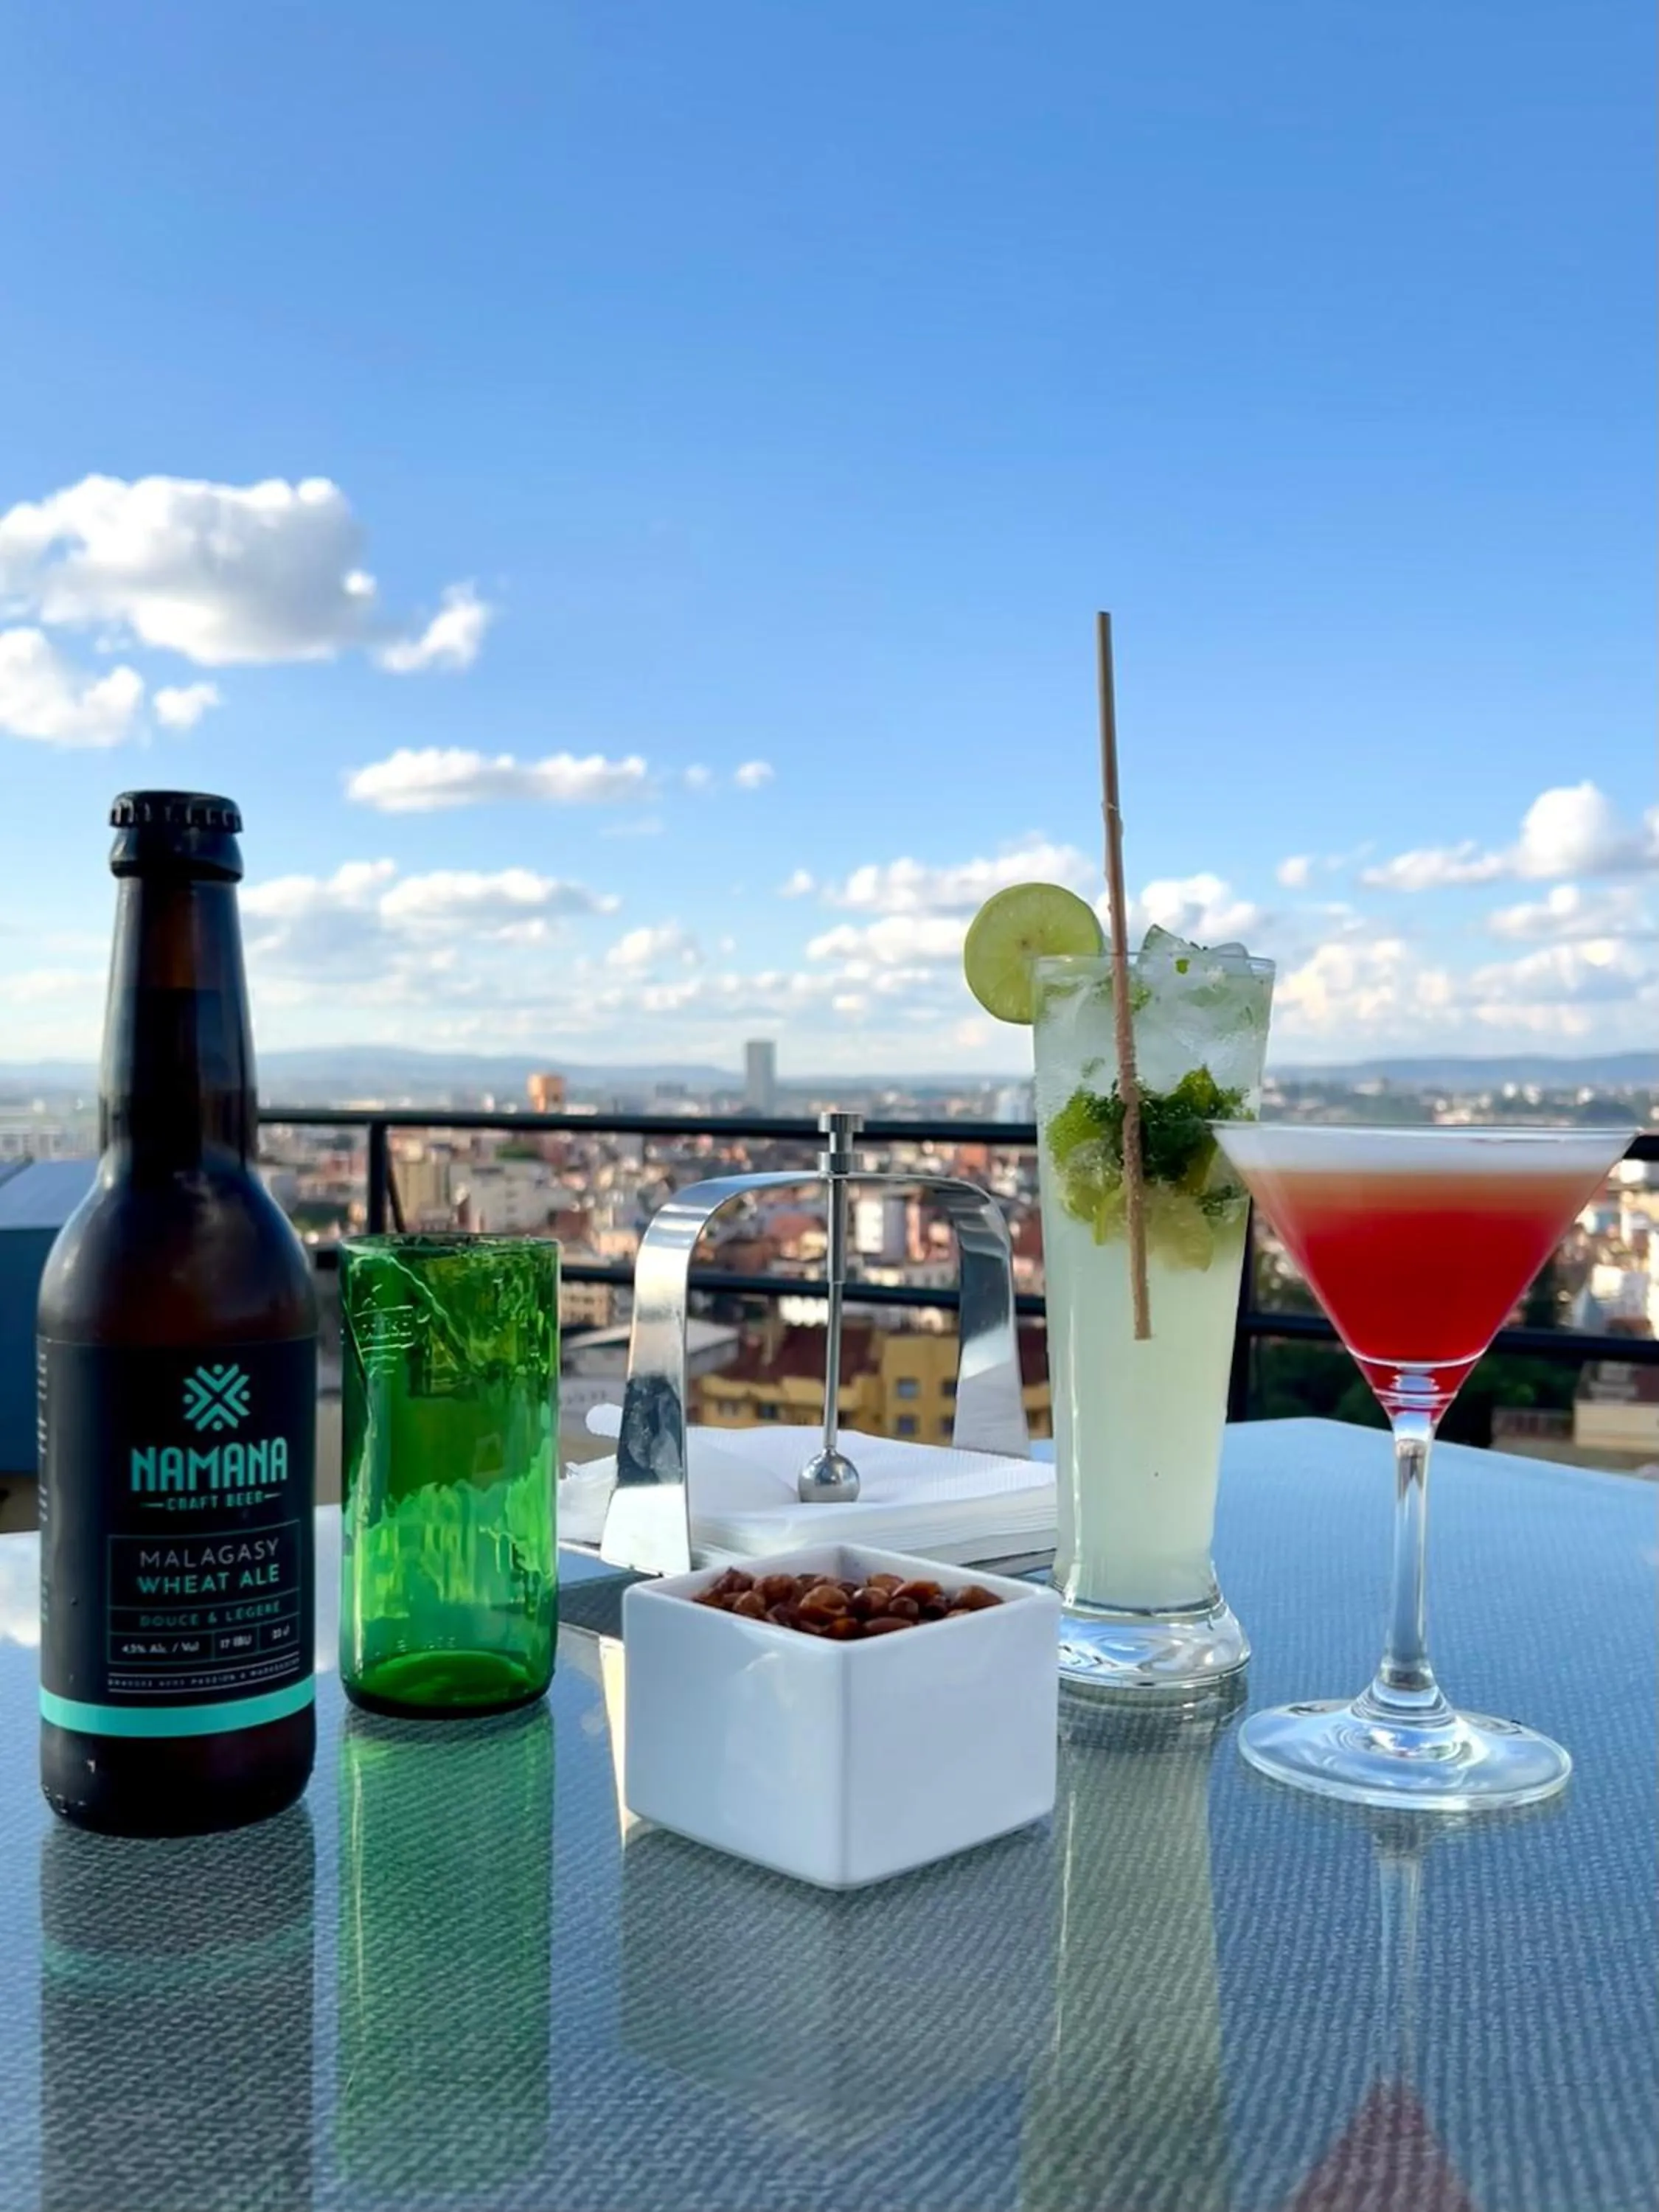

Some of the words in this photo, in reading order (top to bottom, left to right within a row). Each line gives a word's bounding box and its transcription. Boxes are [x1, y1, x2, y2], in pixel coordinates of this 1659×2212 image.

[131, 1436, 288, 1491] NAMANA
[166, 1495, 219, 1510] CRAFT
[226, 1491, 263, 1508] BEER
[140, 1537, 279, 1568] MALAGASY
[136, 1572, 231, 1594] WHEAT
[240, 1563, 280, 1589] ALE
[139, 1613, 199, 1627] DOUCE
